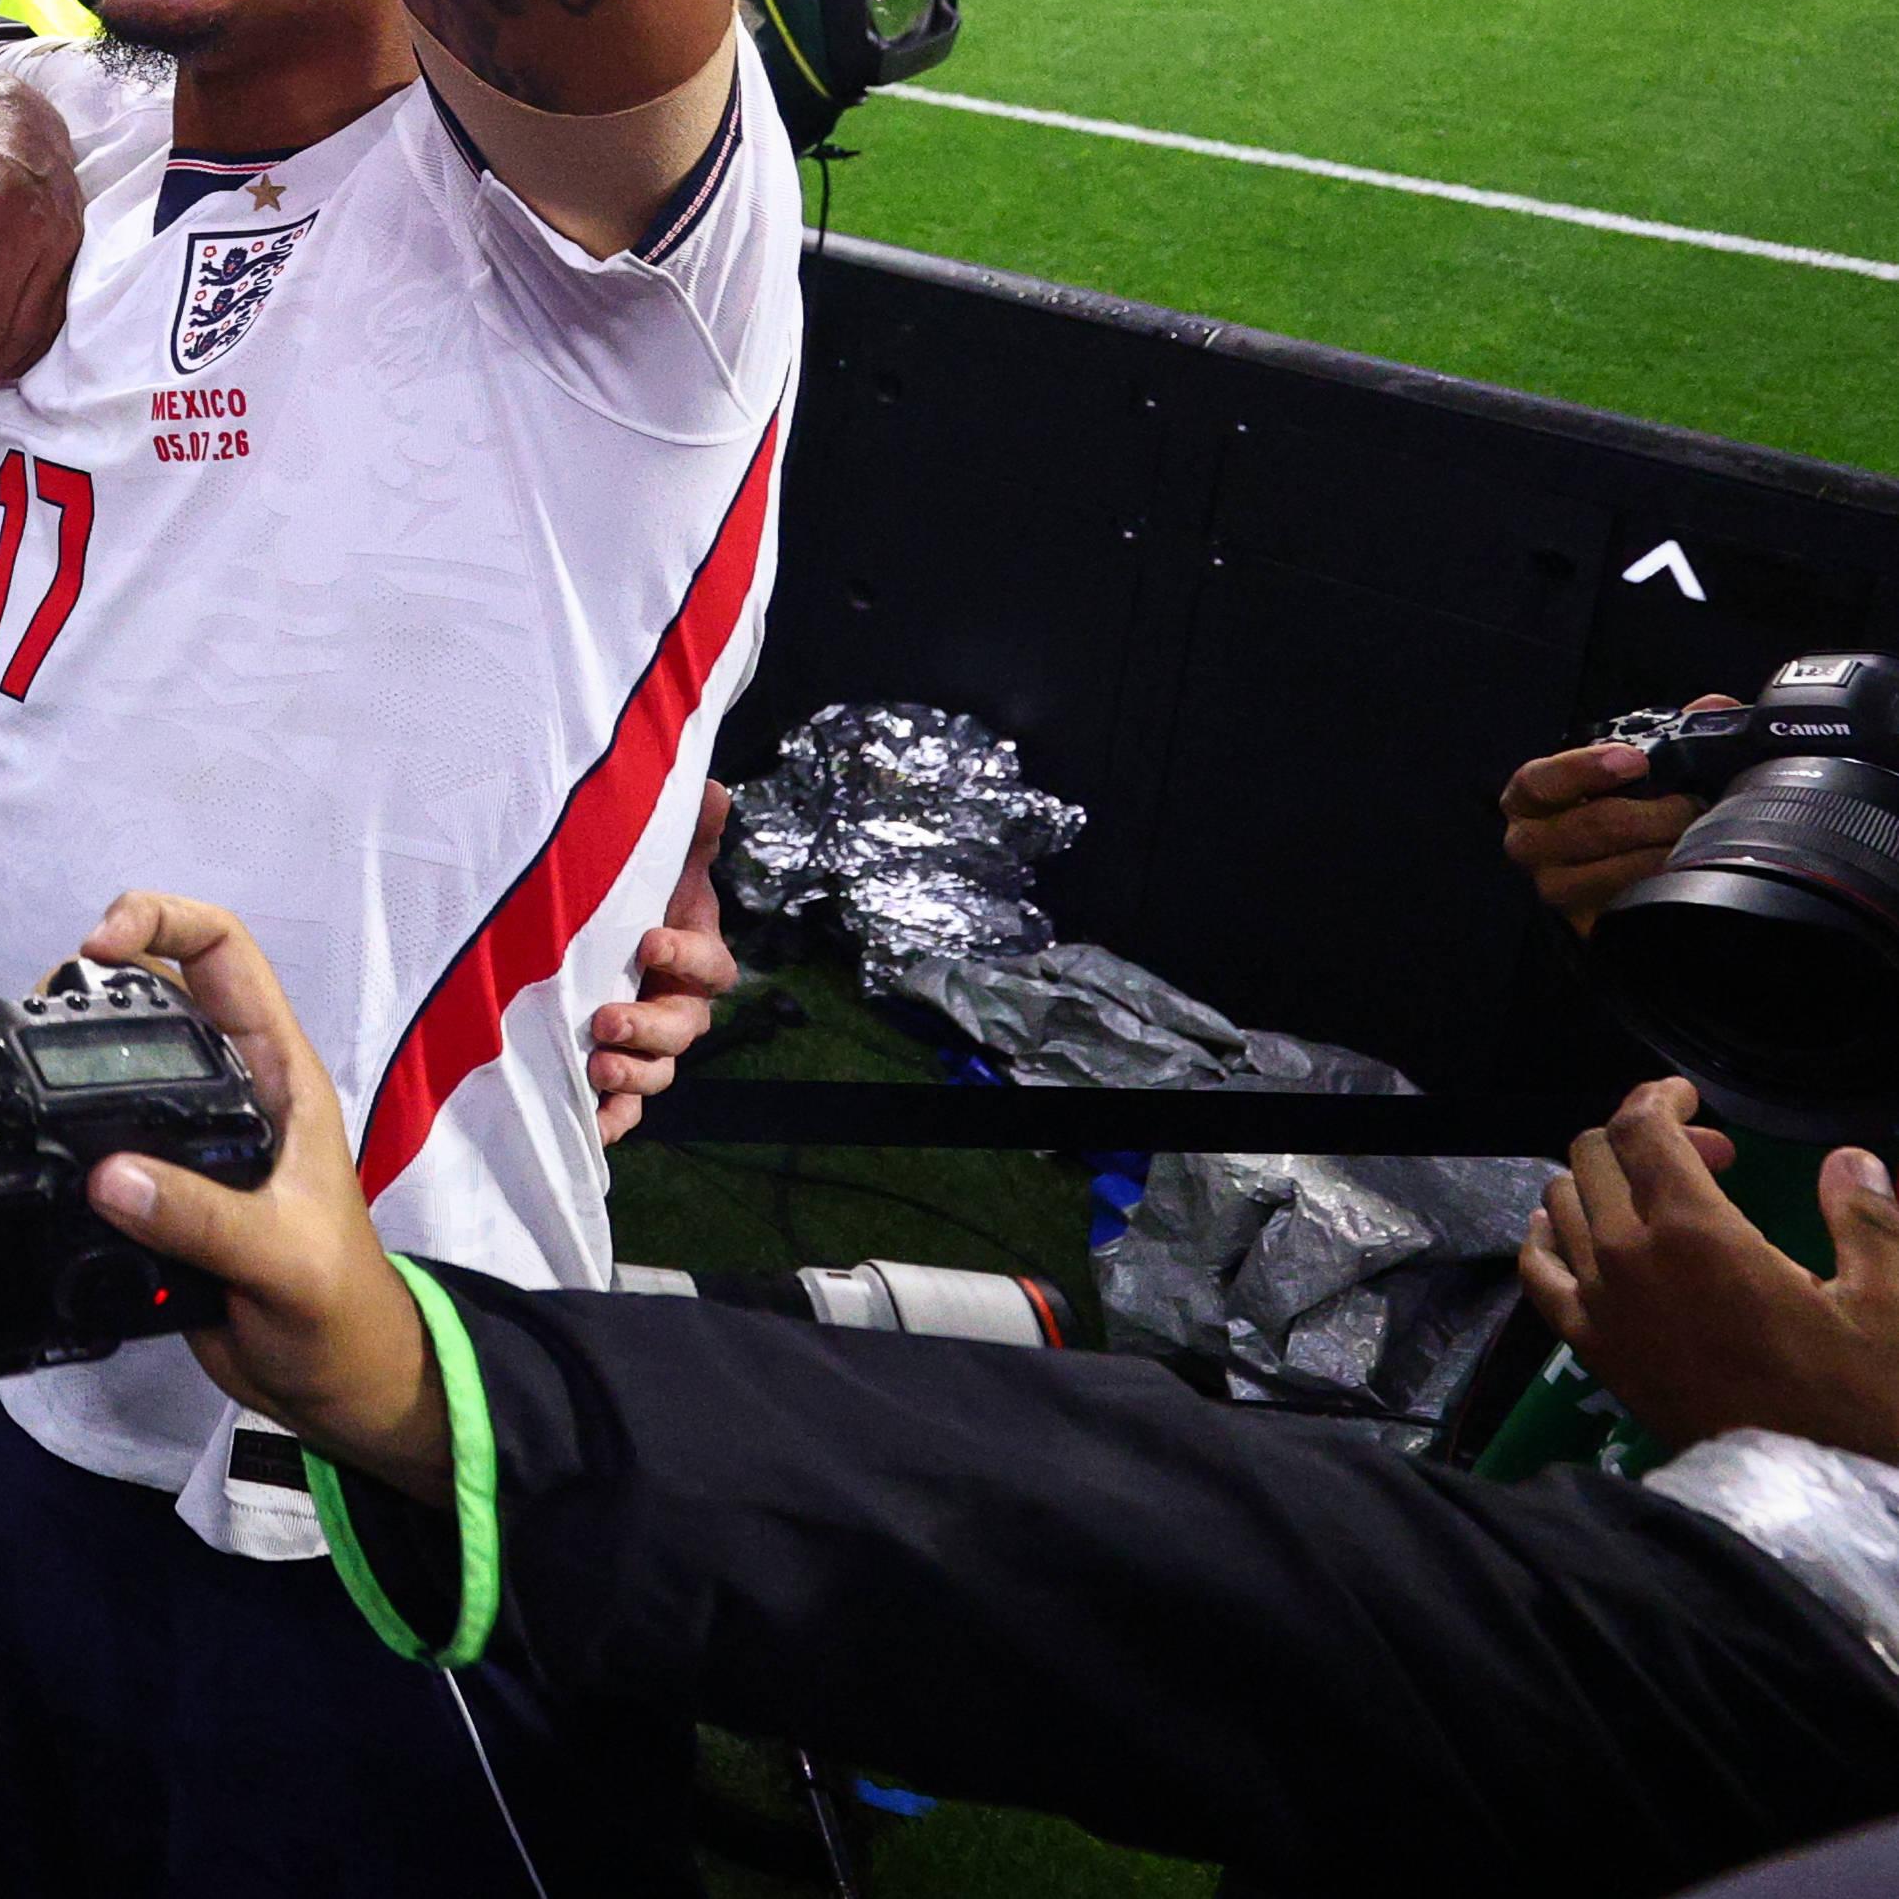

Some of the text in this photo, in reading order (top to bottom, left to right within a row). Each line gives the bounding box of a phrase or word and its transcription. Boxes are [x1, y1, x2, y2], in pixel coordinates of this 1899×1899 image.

[152, 387, 247, 421] MEXICO
[154, 429, 250, 463] 05.07.26
[1768, 720, 1852, 737] Canon
